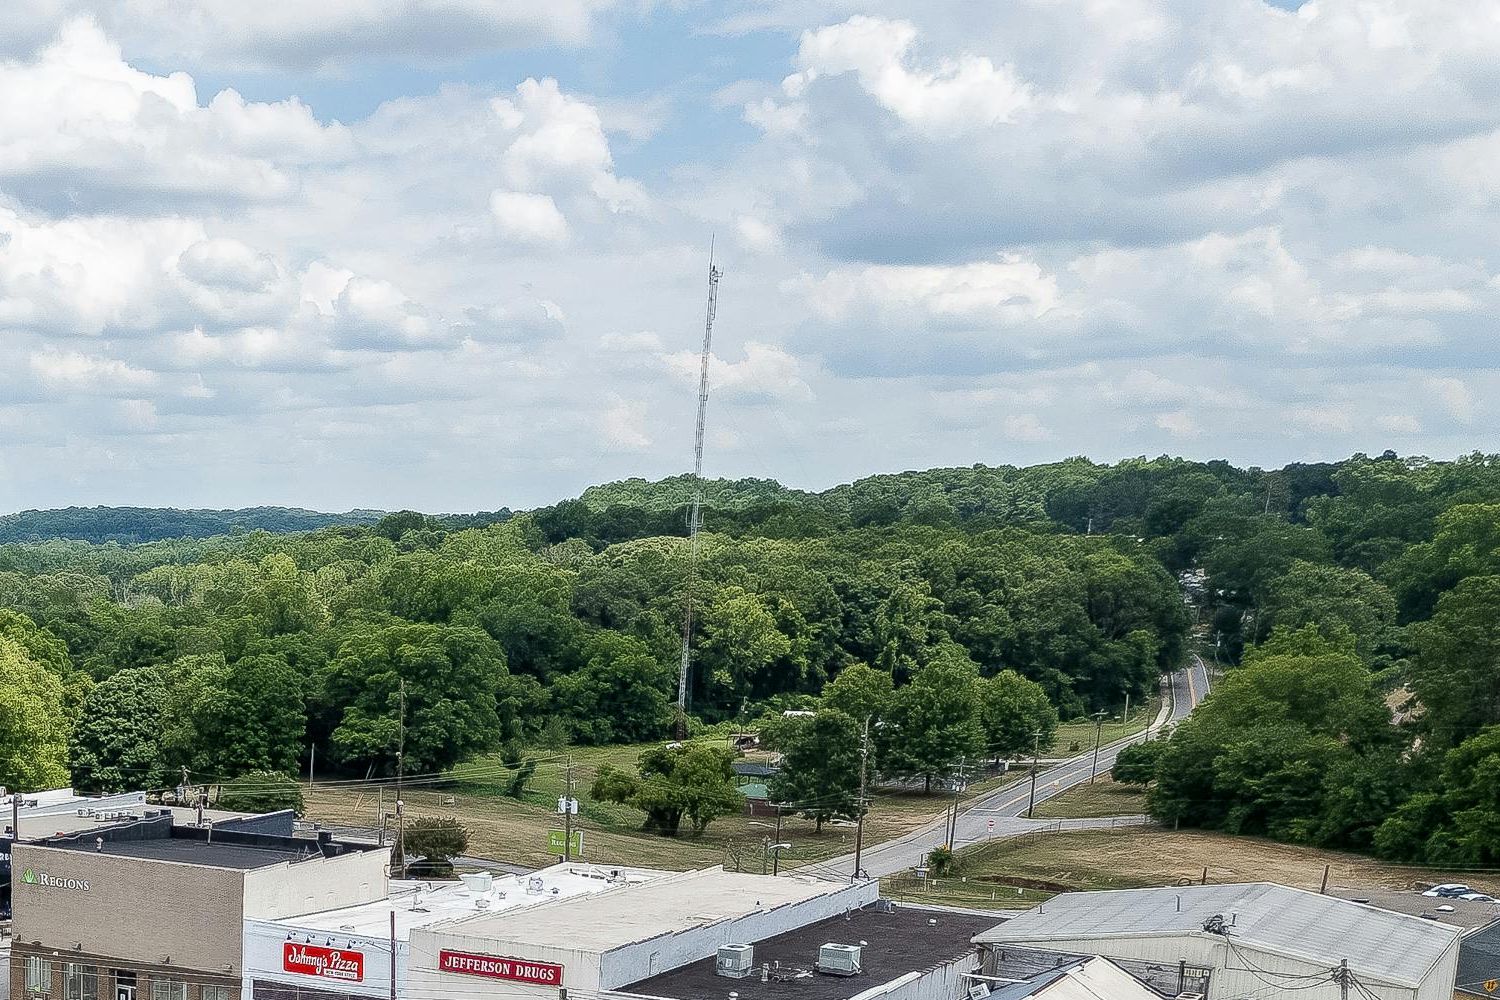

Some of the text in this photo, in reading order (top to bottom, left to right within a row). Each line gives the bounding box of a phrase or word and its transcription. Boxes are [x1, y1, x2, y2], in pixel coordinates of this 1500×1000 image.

[288, 946, 359, 974] Johnny's Pizza
[444, 956, 555, 981] JEFFERSON DRUGS
